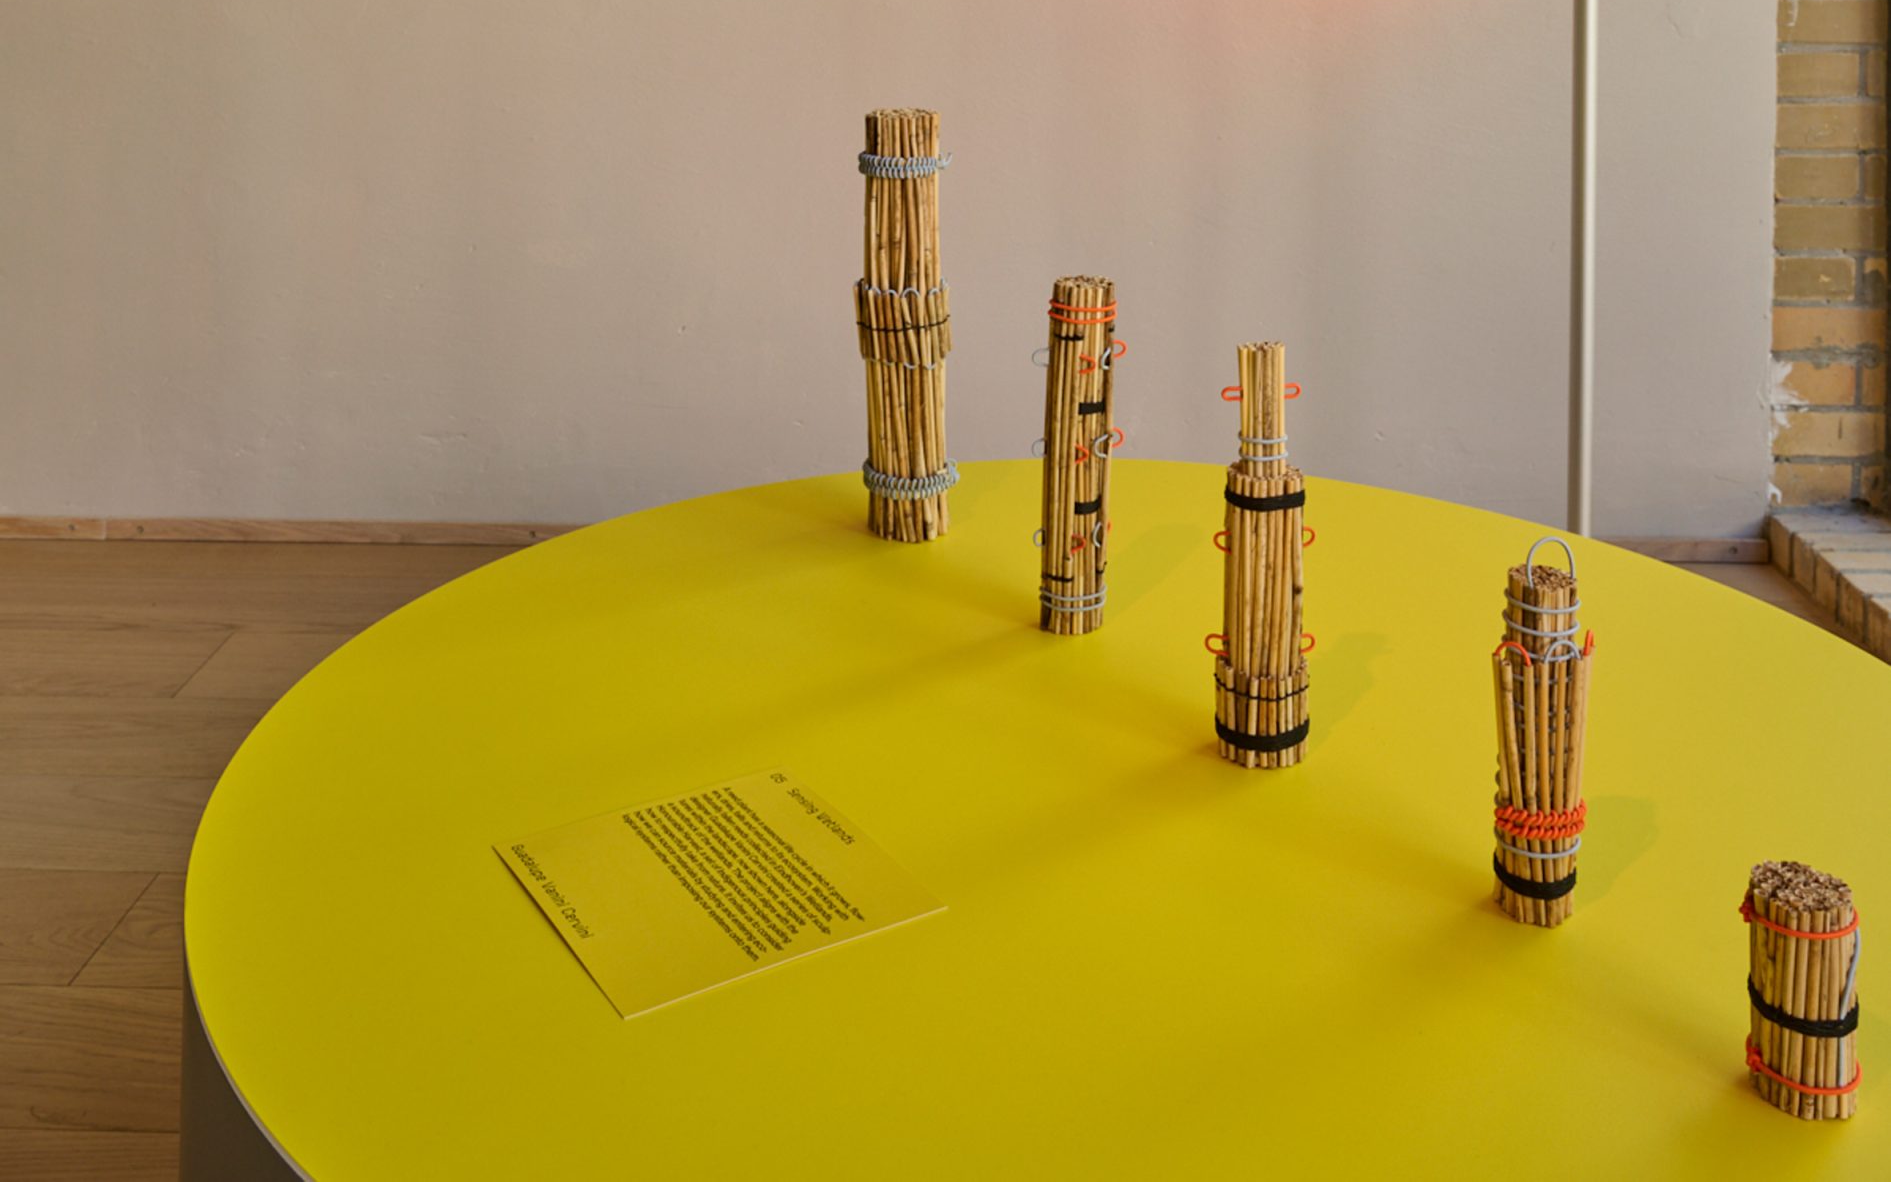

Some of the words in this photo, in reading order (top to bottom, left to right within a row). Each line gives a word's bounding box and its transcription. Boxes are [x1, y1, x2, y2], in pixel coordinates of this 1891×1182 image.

[769, 773, 787, 783] 05
[786, 787, 818, 814] Sensing
[815, 812, 855, 845] Wetlands
[510, 843, 546, 881] Guadalupe
[541, 881, 569, 907] Vanini
[560, 907, 594, 938] Cervini
